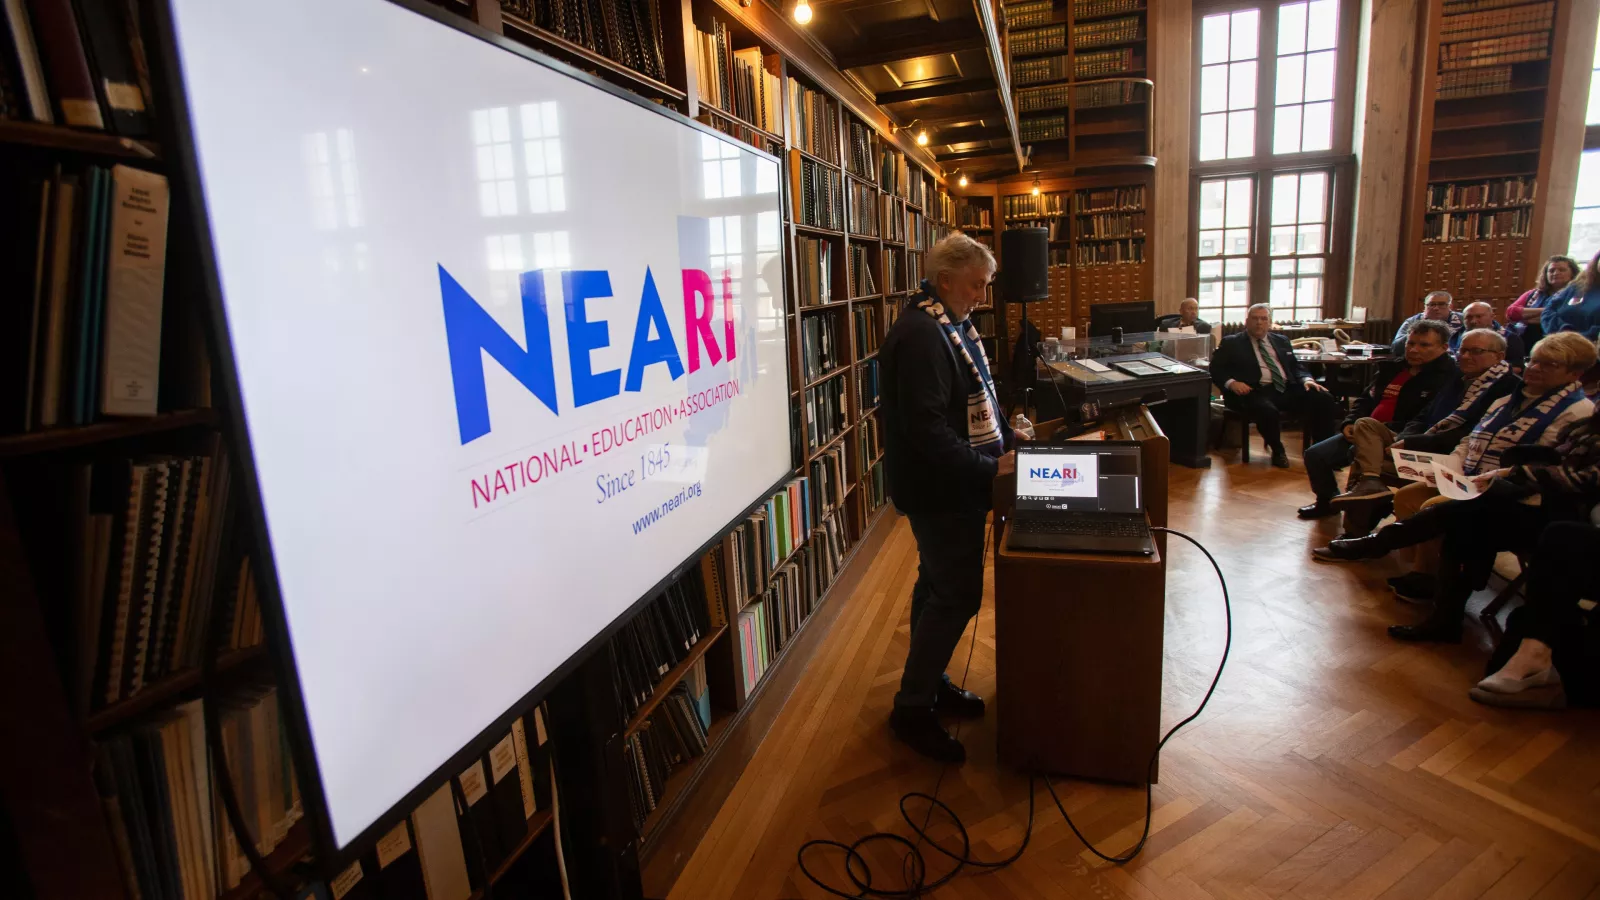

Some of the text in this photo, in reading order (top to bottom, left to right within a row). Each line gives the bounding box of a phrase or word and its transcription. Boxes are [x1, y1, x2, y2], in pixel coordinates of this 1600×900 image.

[437, 261, 737, 446] NEARI
[470, 378, 741, 509] NATIONAL EDUCATION ASSOCIATION
[595, 442, 671, 504] Since 1845
[1030, 467, 1078, 480] NEARI
[632, 480, 702, 535] www.neari.org
